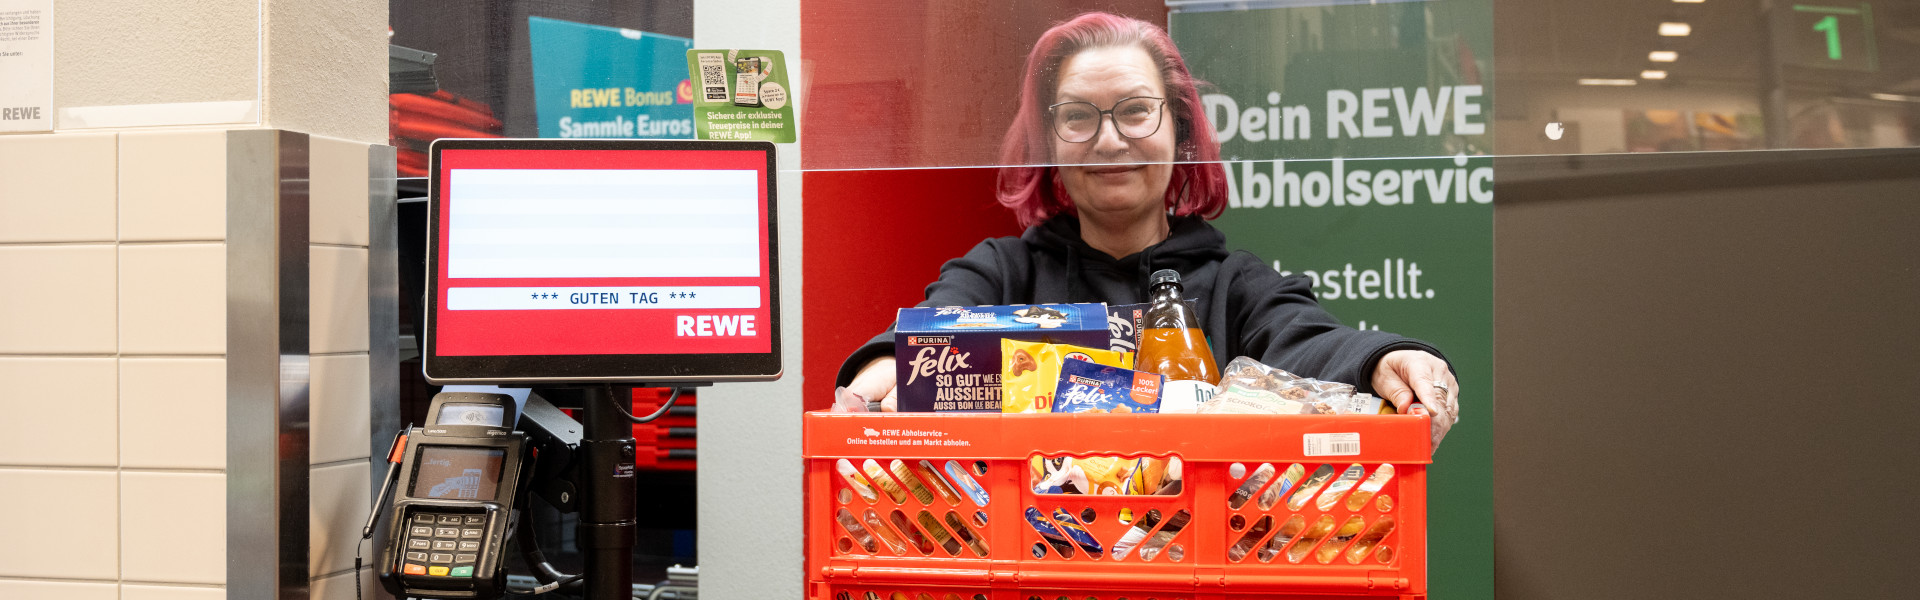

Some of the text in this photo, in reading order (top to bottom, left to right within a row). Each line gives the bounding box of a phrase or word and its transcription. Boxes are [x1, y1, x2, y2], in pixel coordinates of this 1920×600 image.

[1813, 16, 1842, 60] 1
[571, 88, 673, 108] REWE Bonus
[2, 106, 40, 120] REWE
[1202, 85, 1485, 143] Dein REWE
[559, 114, 691, 138] Sammle Euros
[708, 122, 750, 130] Treuepreise
[734, 131, 752, 140] App!
[570, 292, 619, 304] GUTEN
[630, 292, 658, 304] TAG
[677, 315, 756, 336] REWE
[906, 346, 970, 386] felix
[936, 374, 952, 387] SO
[956, 374, 981, 386] GUT
[983, 374, 994, 383] WIE
[1076, 377, 1100, 386] PURINA
[936, 387, 1002, 401] AUSSIEHT
[1059, 384, 1112, 408] felix
[1132, 386, 1158, 394] Lecker!
[934, 402, 956, 410] AUSSI
[958, 401, 974, 409] BON
